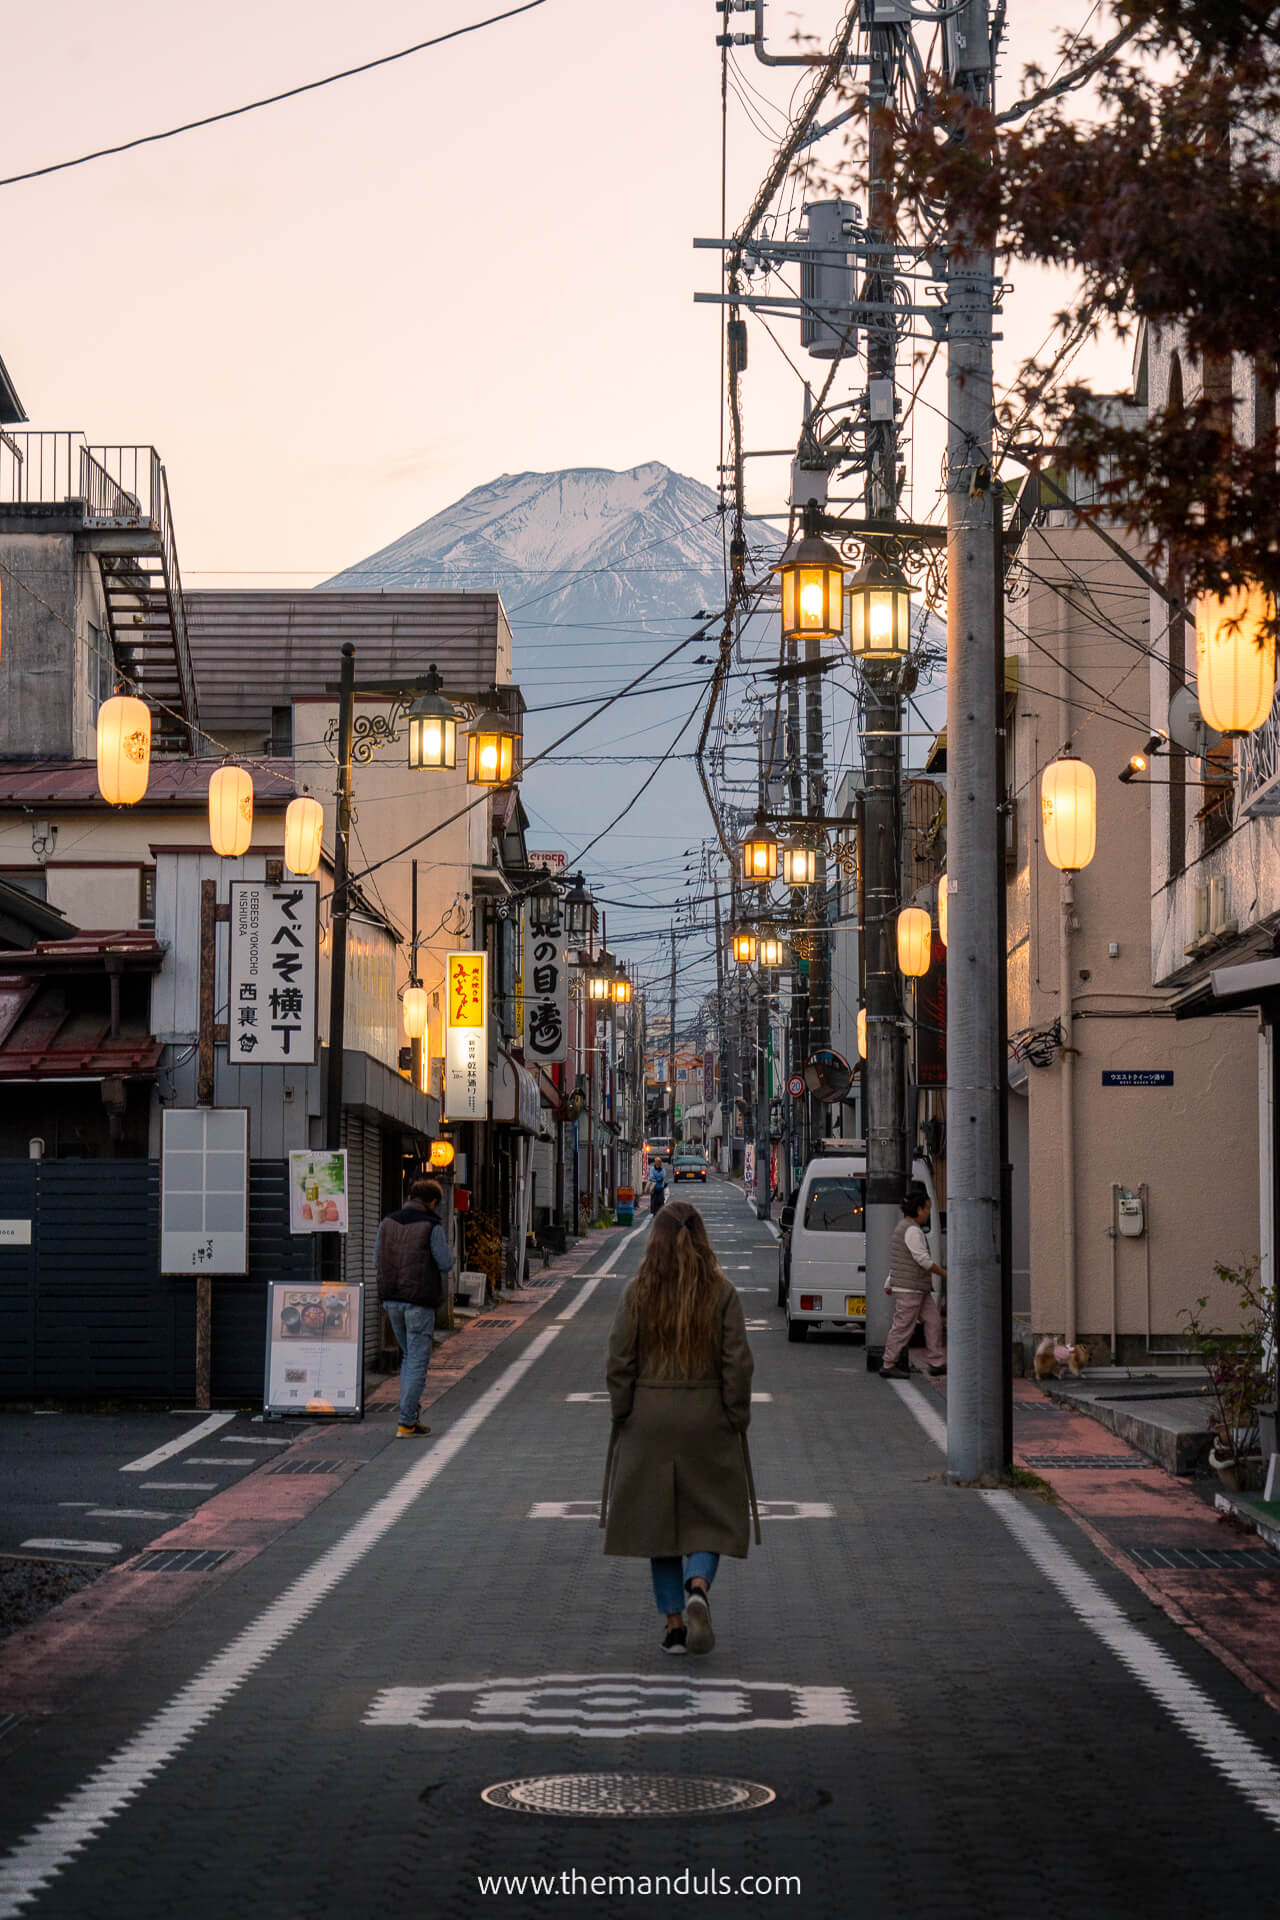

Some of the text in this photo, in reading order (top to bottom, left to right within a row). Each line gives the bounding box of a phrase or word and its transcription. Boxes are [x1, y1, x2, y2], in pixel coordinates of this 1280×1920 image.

[239, 891, 248, 937] NISHIURA
[250, 891, 260, 976] DEBESO YOKOCHO
[268, 889, 304, 1055] でべそ横丁
[791, 1081, 801, 1091] 20
